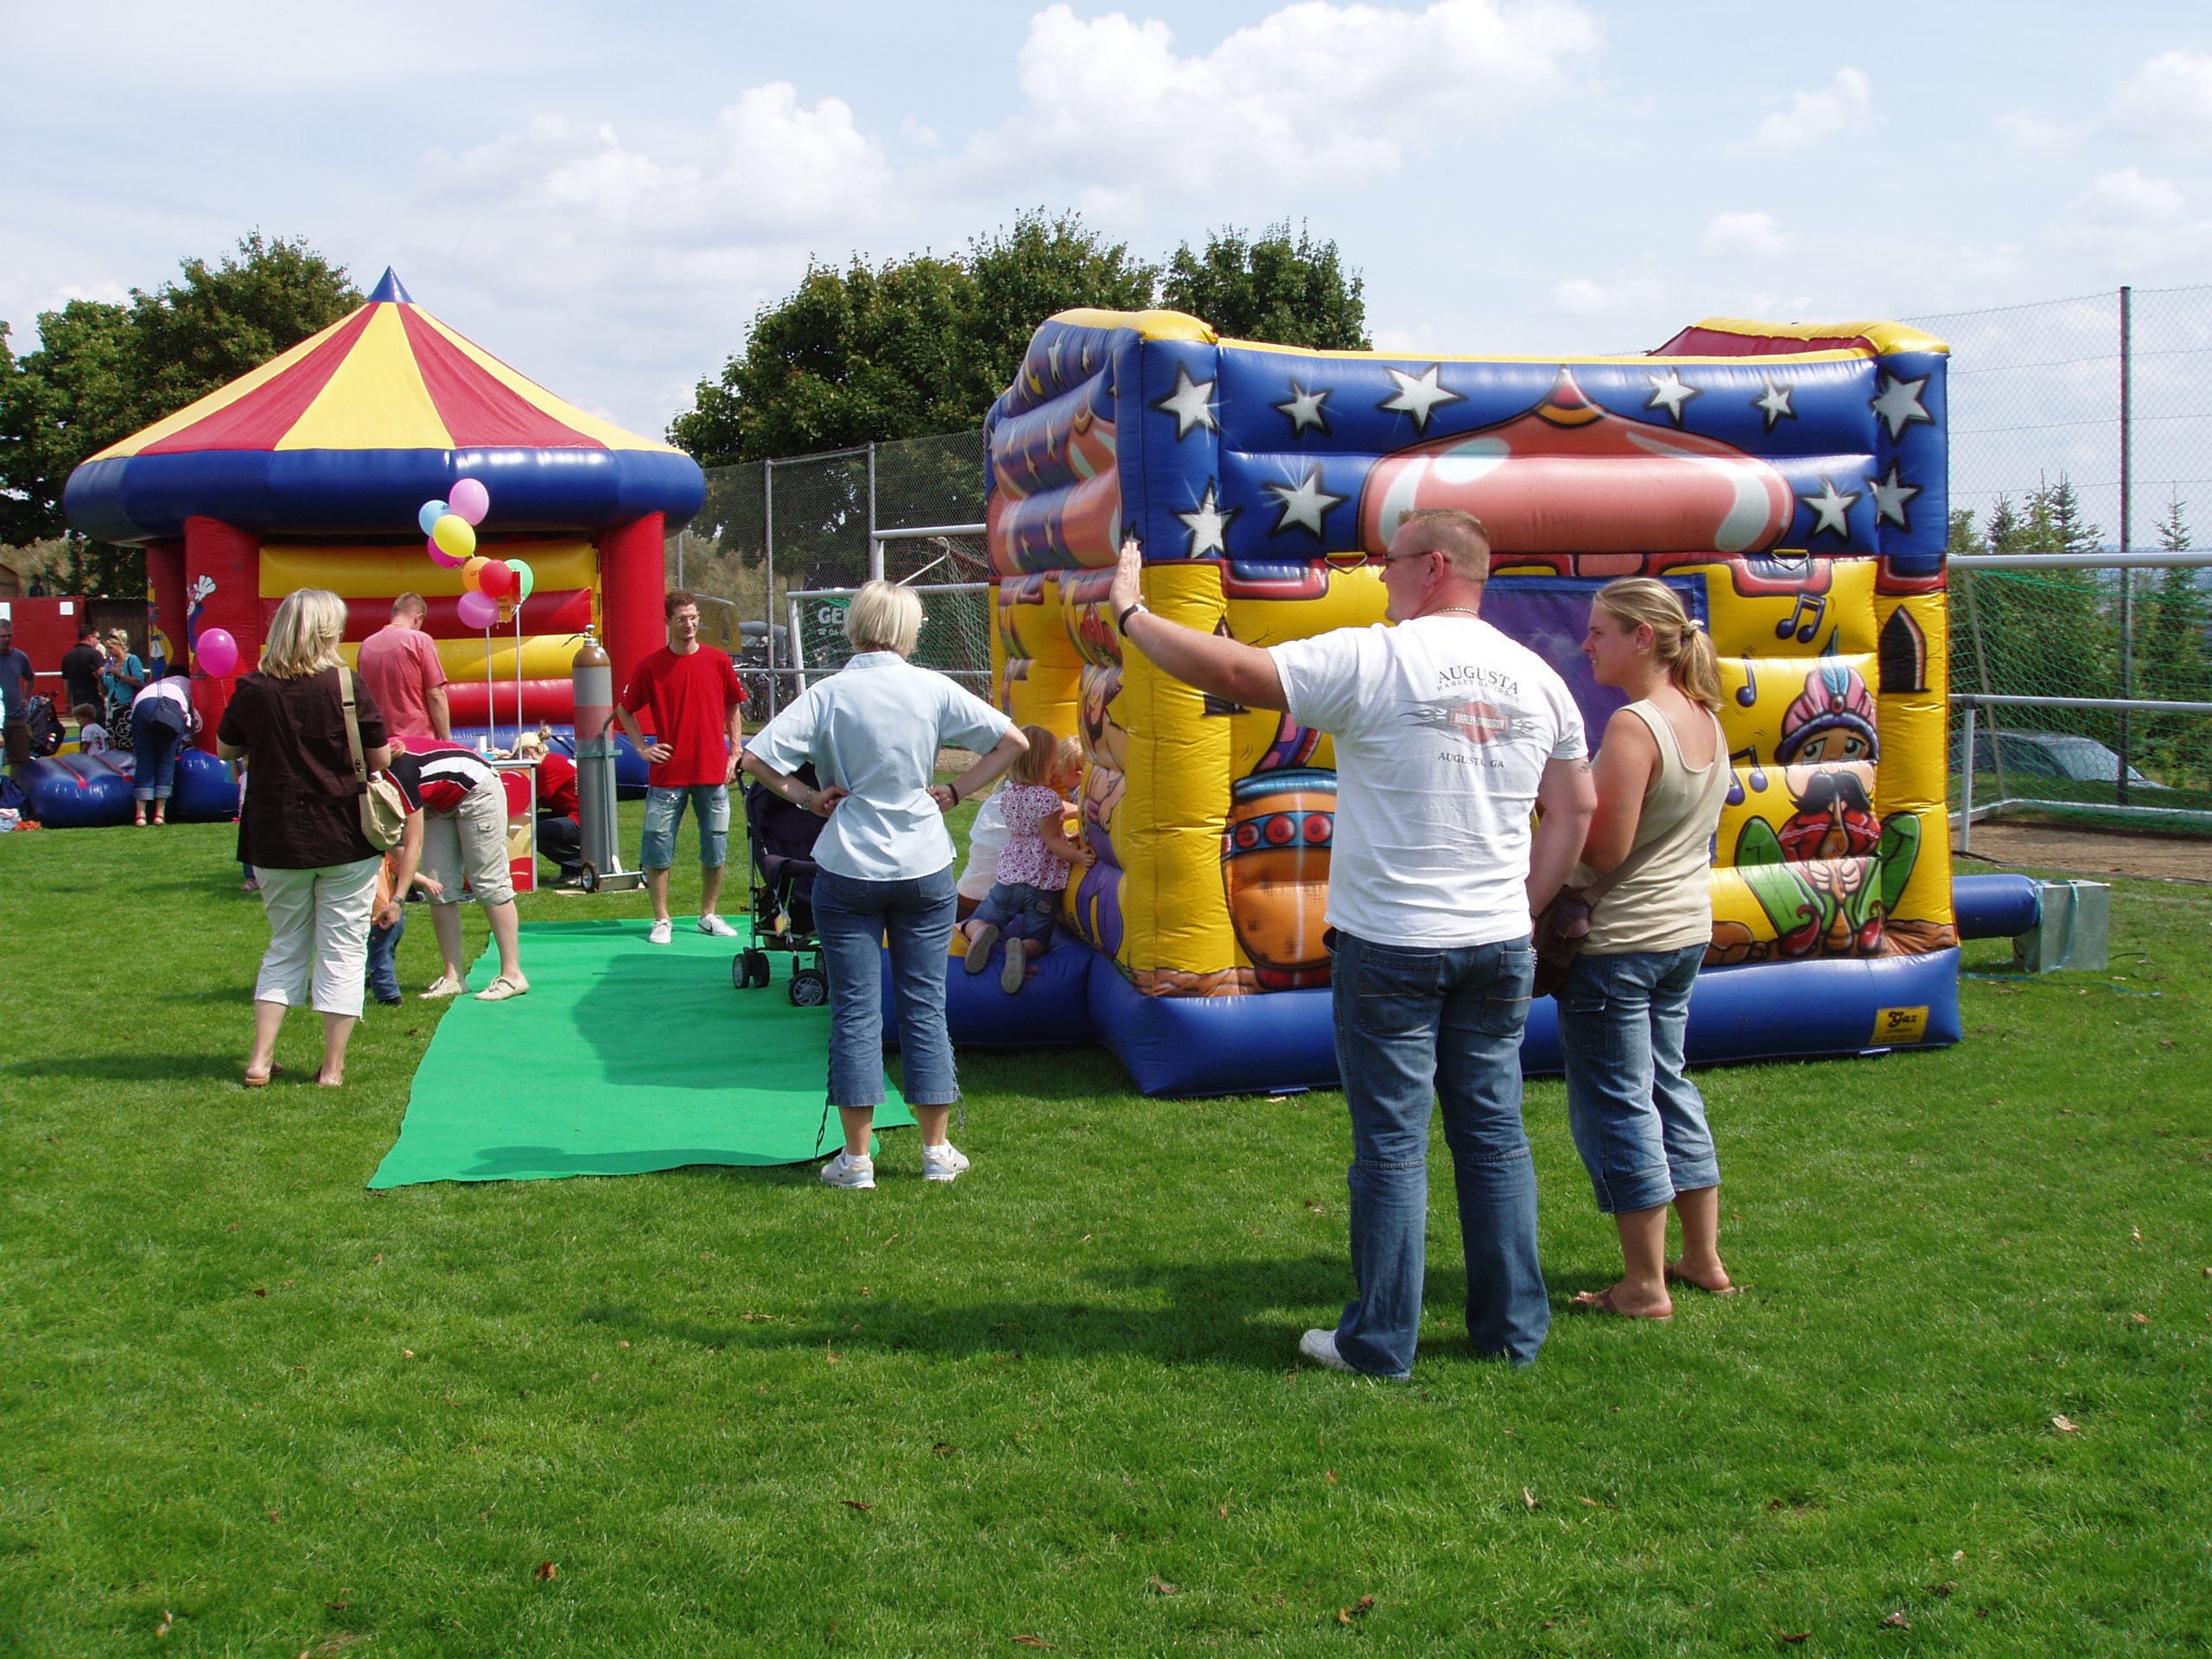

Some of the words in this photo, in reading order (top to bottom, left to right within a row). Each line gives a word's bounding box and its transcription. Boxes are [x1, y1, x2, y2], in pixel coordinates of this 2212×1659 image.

[1439, 665, 1519, 695] AUGUSTA
[1478, 680, 1521, 702] DAIDSON
[1490, 760, 1504, 768] GA
